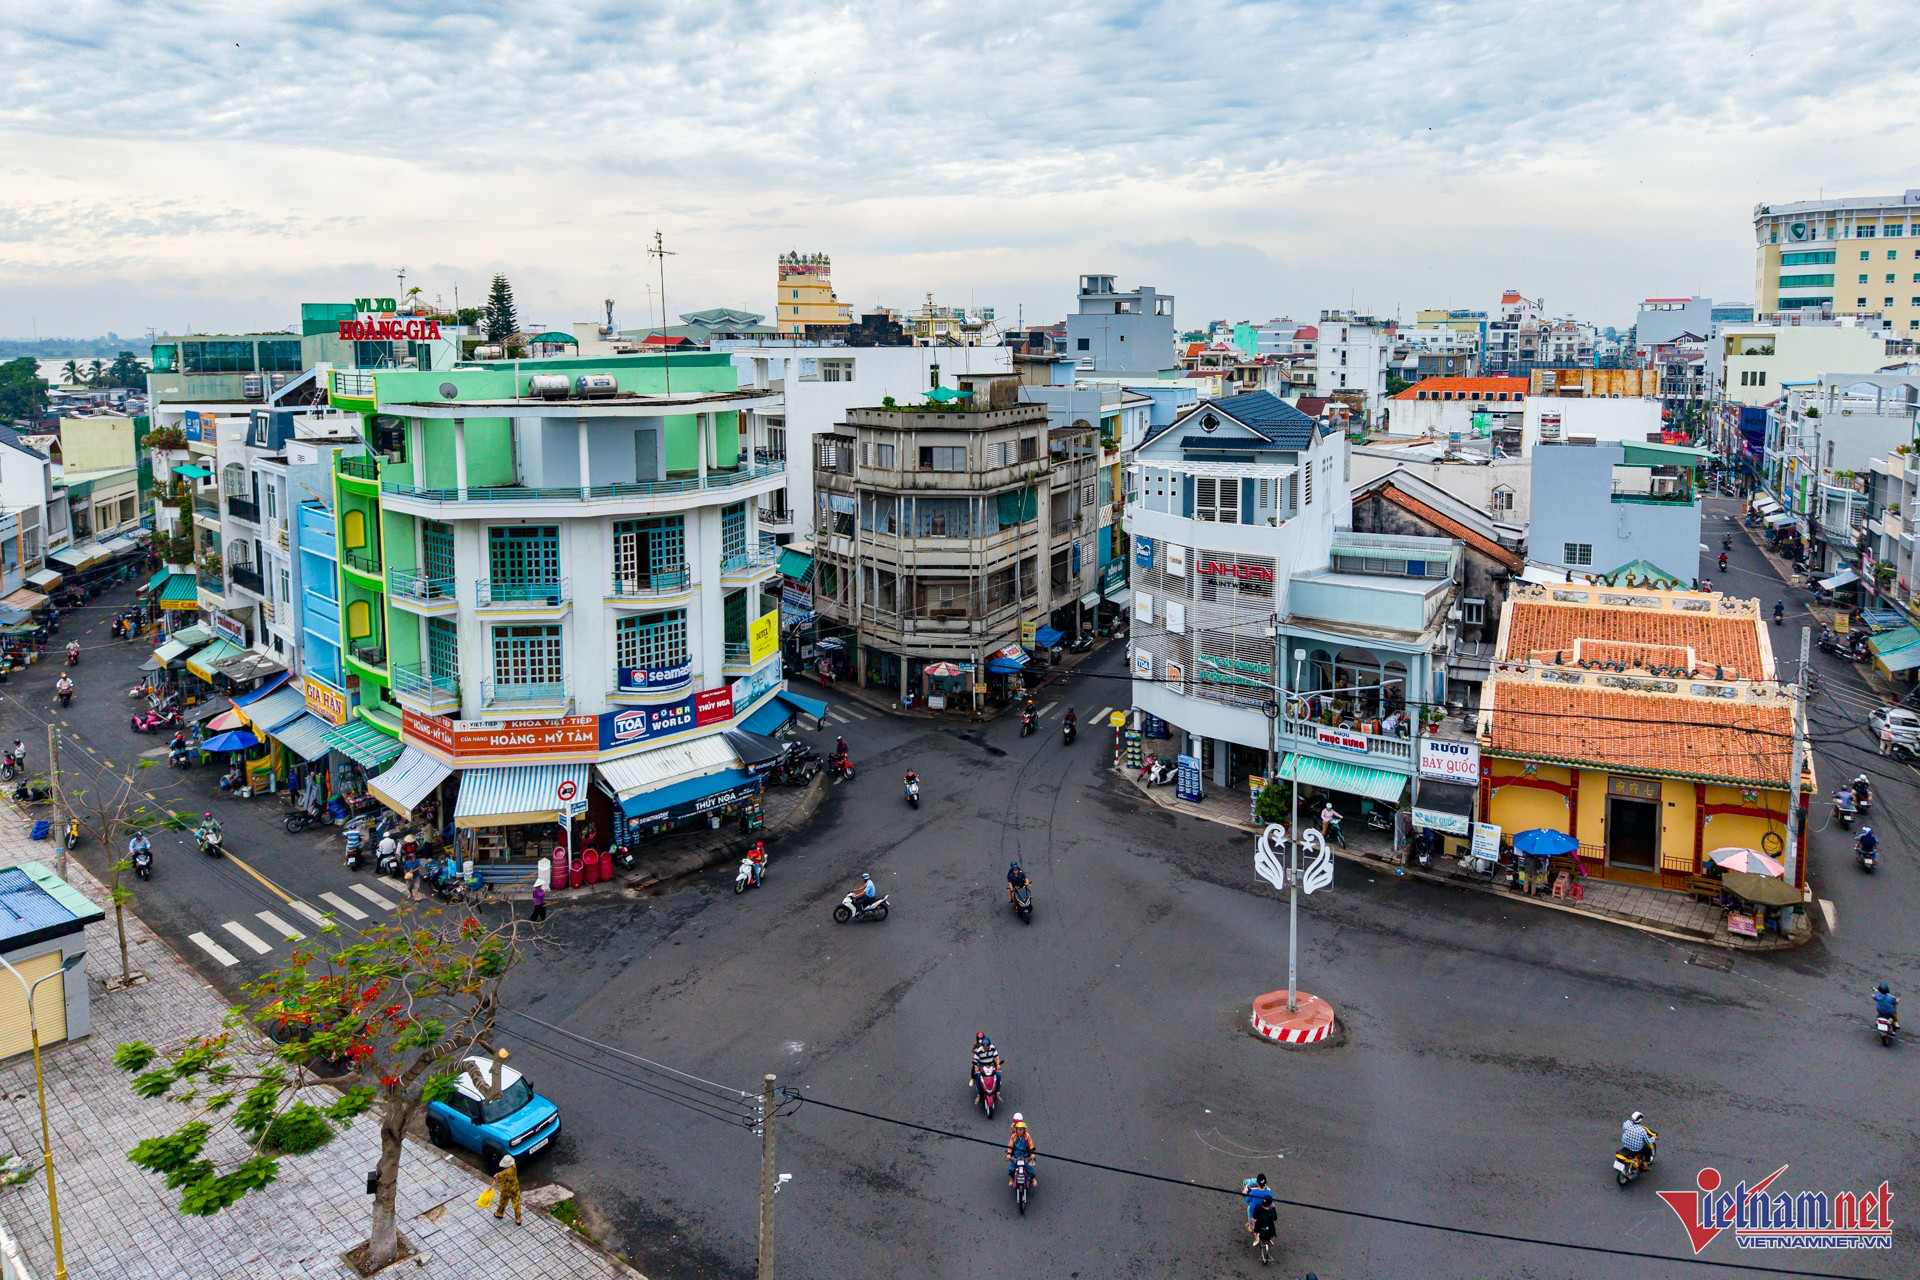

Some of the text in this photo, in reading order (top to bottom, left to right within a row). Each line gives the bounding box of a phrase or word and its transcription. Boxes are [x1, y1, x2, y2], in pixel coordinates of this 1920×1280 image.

[355, 298, 397, 313] VLXD
[339, 315, 442, 341] HOÀNG GIA
[307, 683, 322, 704] GIA
[323, 691, 343, 715] HÀN
[716, 698, 731, 708] NGA
[652, 705, 691, 720] COLOR
[617, 717, 644, 733] TOA
[651, 714, 692, 731] WORLD
[490, 732, 536, 746] HOÀNG
[545, 730, 564, 744] MỸ
[567, 728, 593, 743] TÂM
[1430, 742, 1469, 756] RƯỢU
[1422, 754, 1476, 774] BẢY QUỐC
[718, 792, 737, 804] NGA
[639, 811, 669, 824] seamaster
